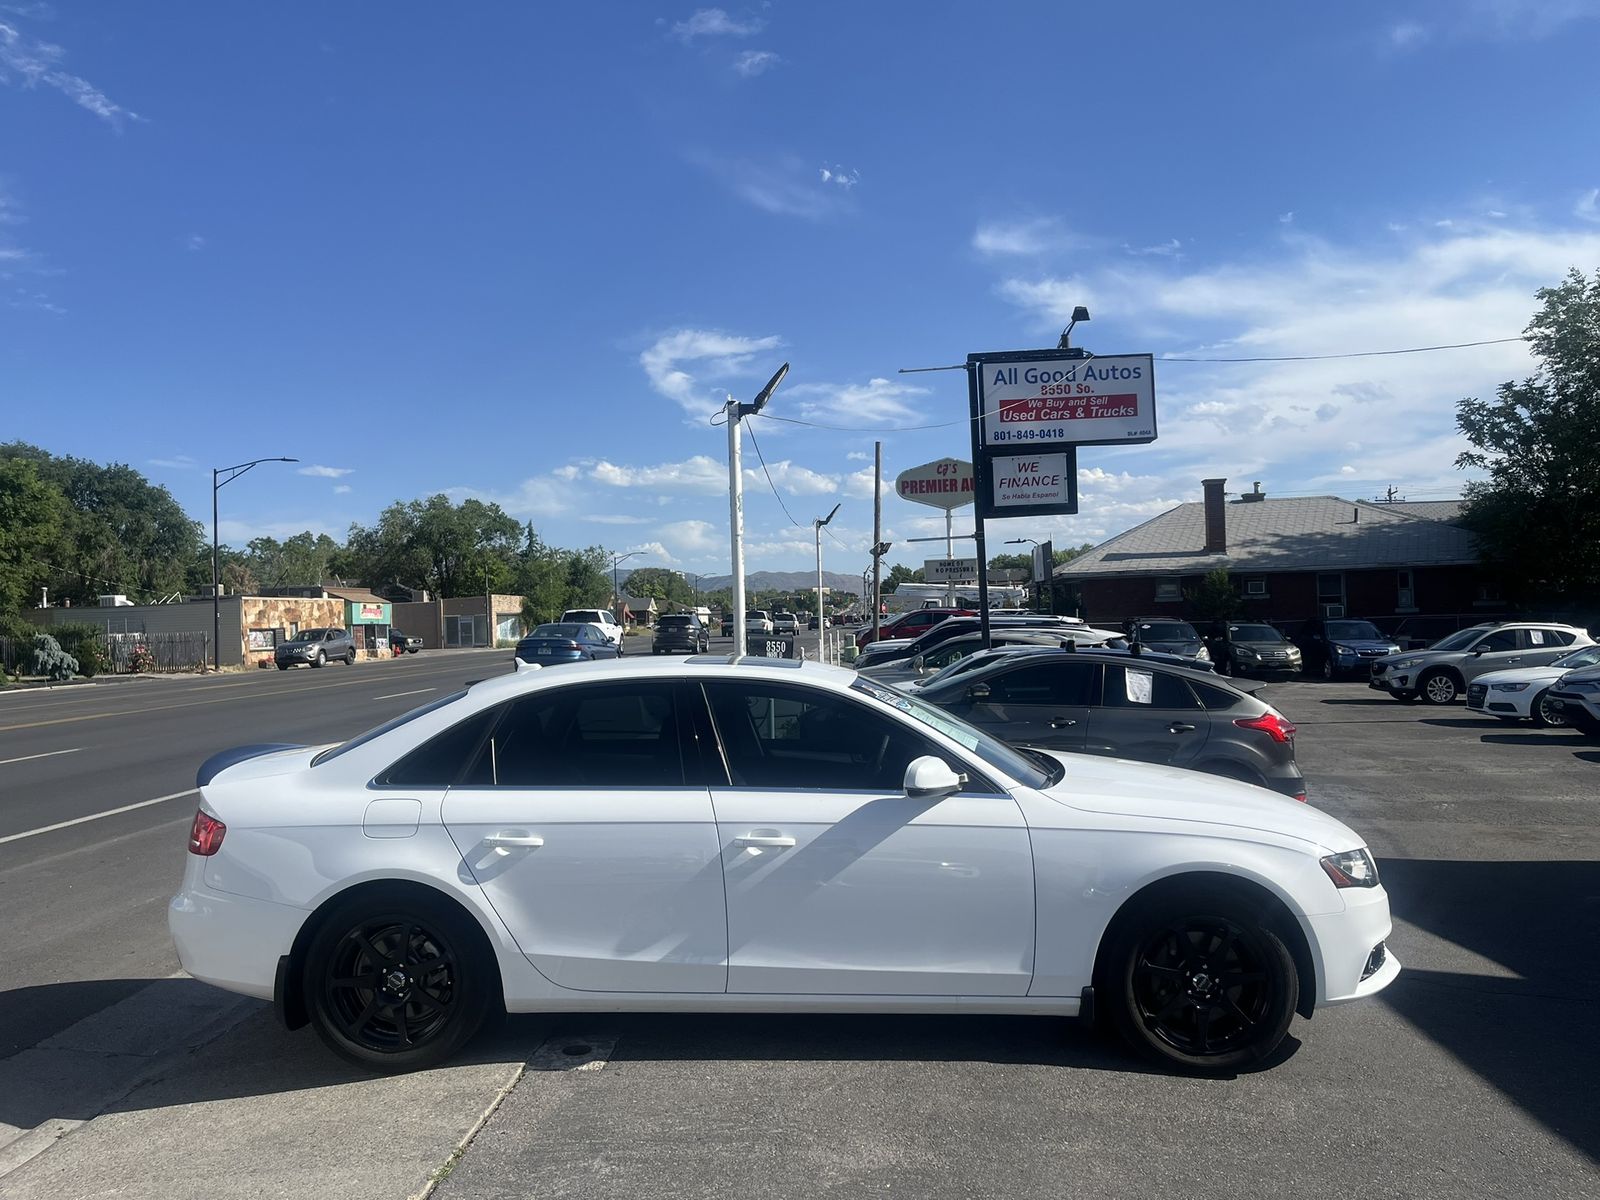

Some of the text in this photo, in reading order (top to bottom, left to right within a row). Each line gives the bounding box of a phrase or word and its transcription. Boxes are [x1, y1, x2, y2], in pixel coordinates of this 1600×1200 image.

[993, 365, 1142, 386] All Good Autos
[1040, 383, 1095, 396] 8550 So.
[1028, 396, 1108, 409] We Buy and Sell
[1003, 405, 1135, 422] Used Cars & Trucks
[993, 428, 1065, 441] 801-849-0418
[1017, 461, 1040, 473] WE
[901, 478, 958, 495] PREMIER
[999, 475, 1060, 489] FINANCE
[766, 640, 786, 652] 8550
